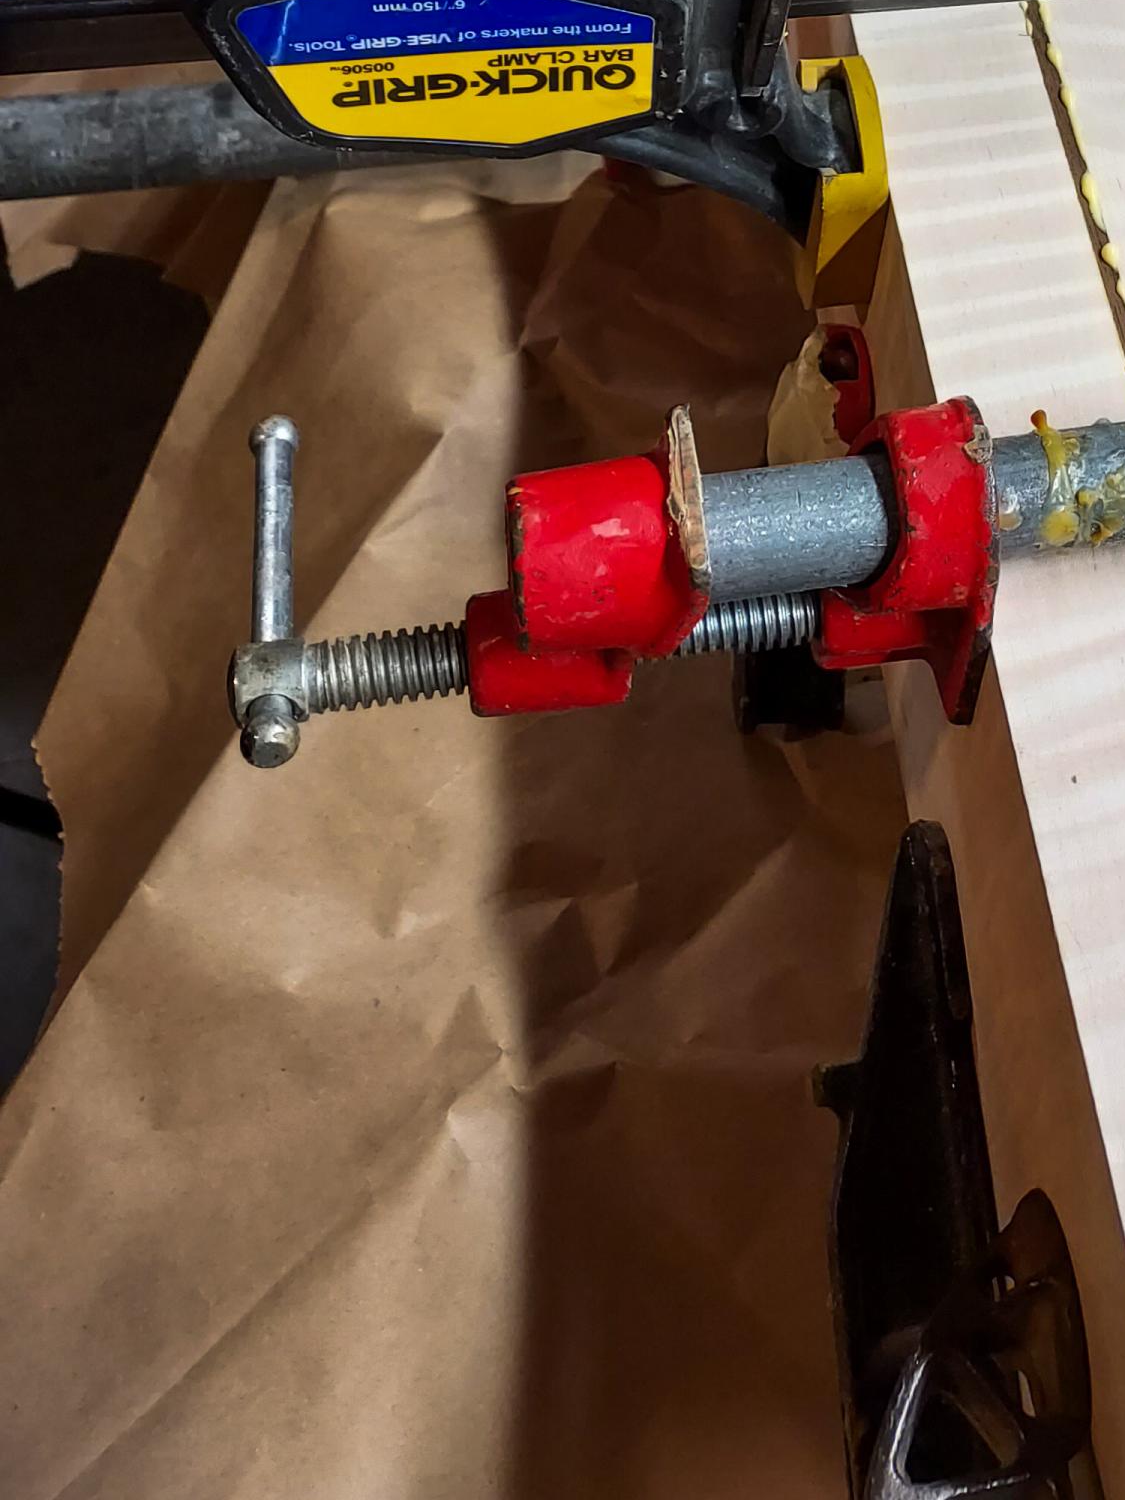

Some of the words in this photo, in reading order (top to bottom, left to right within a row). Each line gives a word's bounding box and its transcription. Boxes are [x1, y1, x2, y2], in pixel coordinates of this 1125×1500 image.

[481, 26, 548, 39] makers
[552, 24, 581, 36] the
[586, 23, 632, 35] From
[458, 30, 477, 43] of
[288, 40, 346, 53] Tools.
[487, 50, 575, 67] CLAMP
[582, 48, 634, 63] BAR
